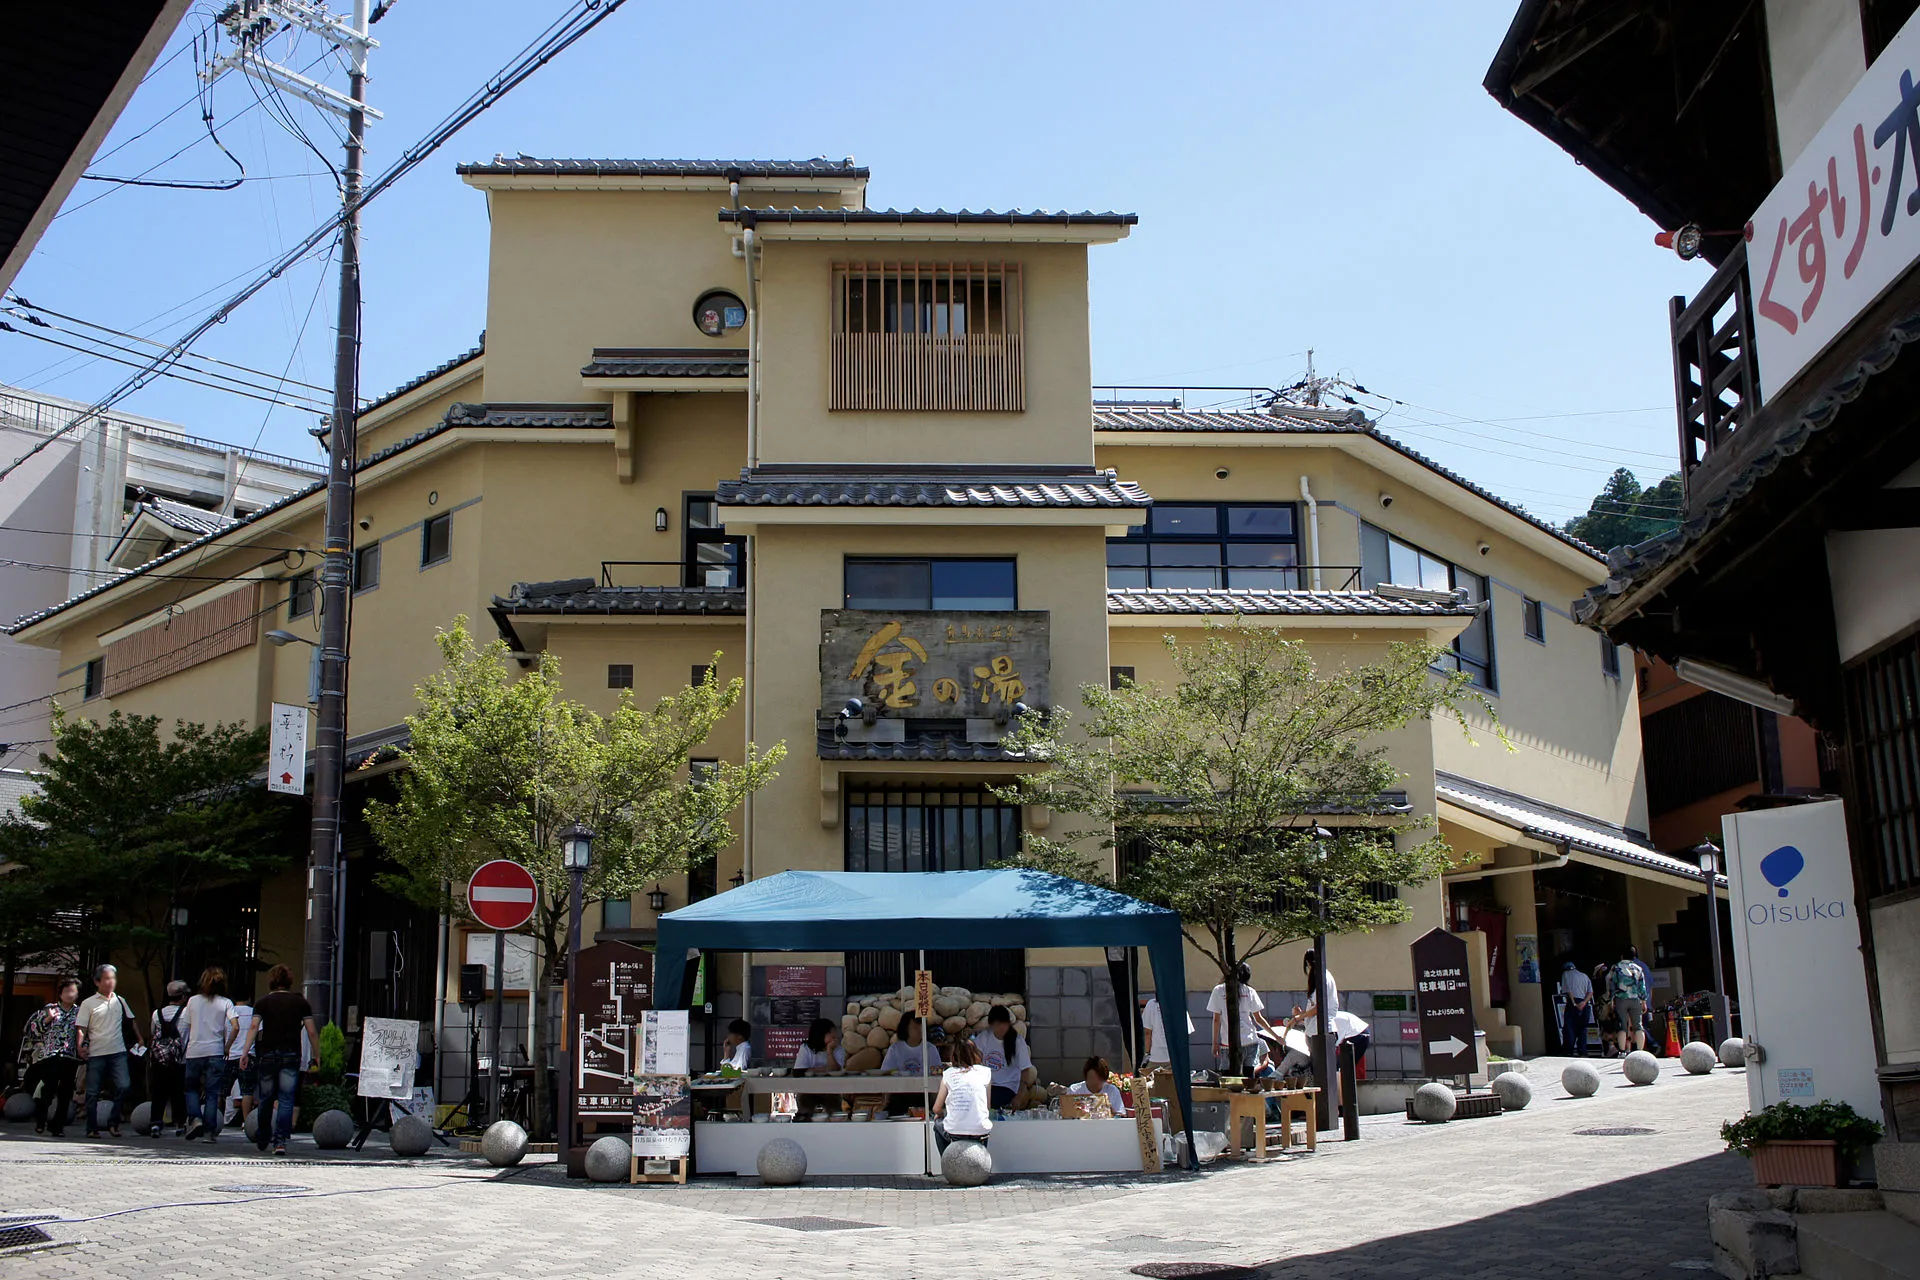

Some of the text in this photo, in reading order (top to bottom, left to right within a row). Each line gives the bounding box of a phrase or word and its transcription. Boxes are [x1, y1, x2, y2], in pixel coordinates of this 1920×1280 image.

[848, 619, 1027, 709] 金の湯
[1747, 897, 1845, 925] Otsuka
[1419, 980, 1446, 992] 駐車場
[1426, 1007, 1465, 1016] これより50m先
[578, 1096, 609, 1106] 駐車場
